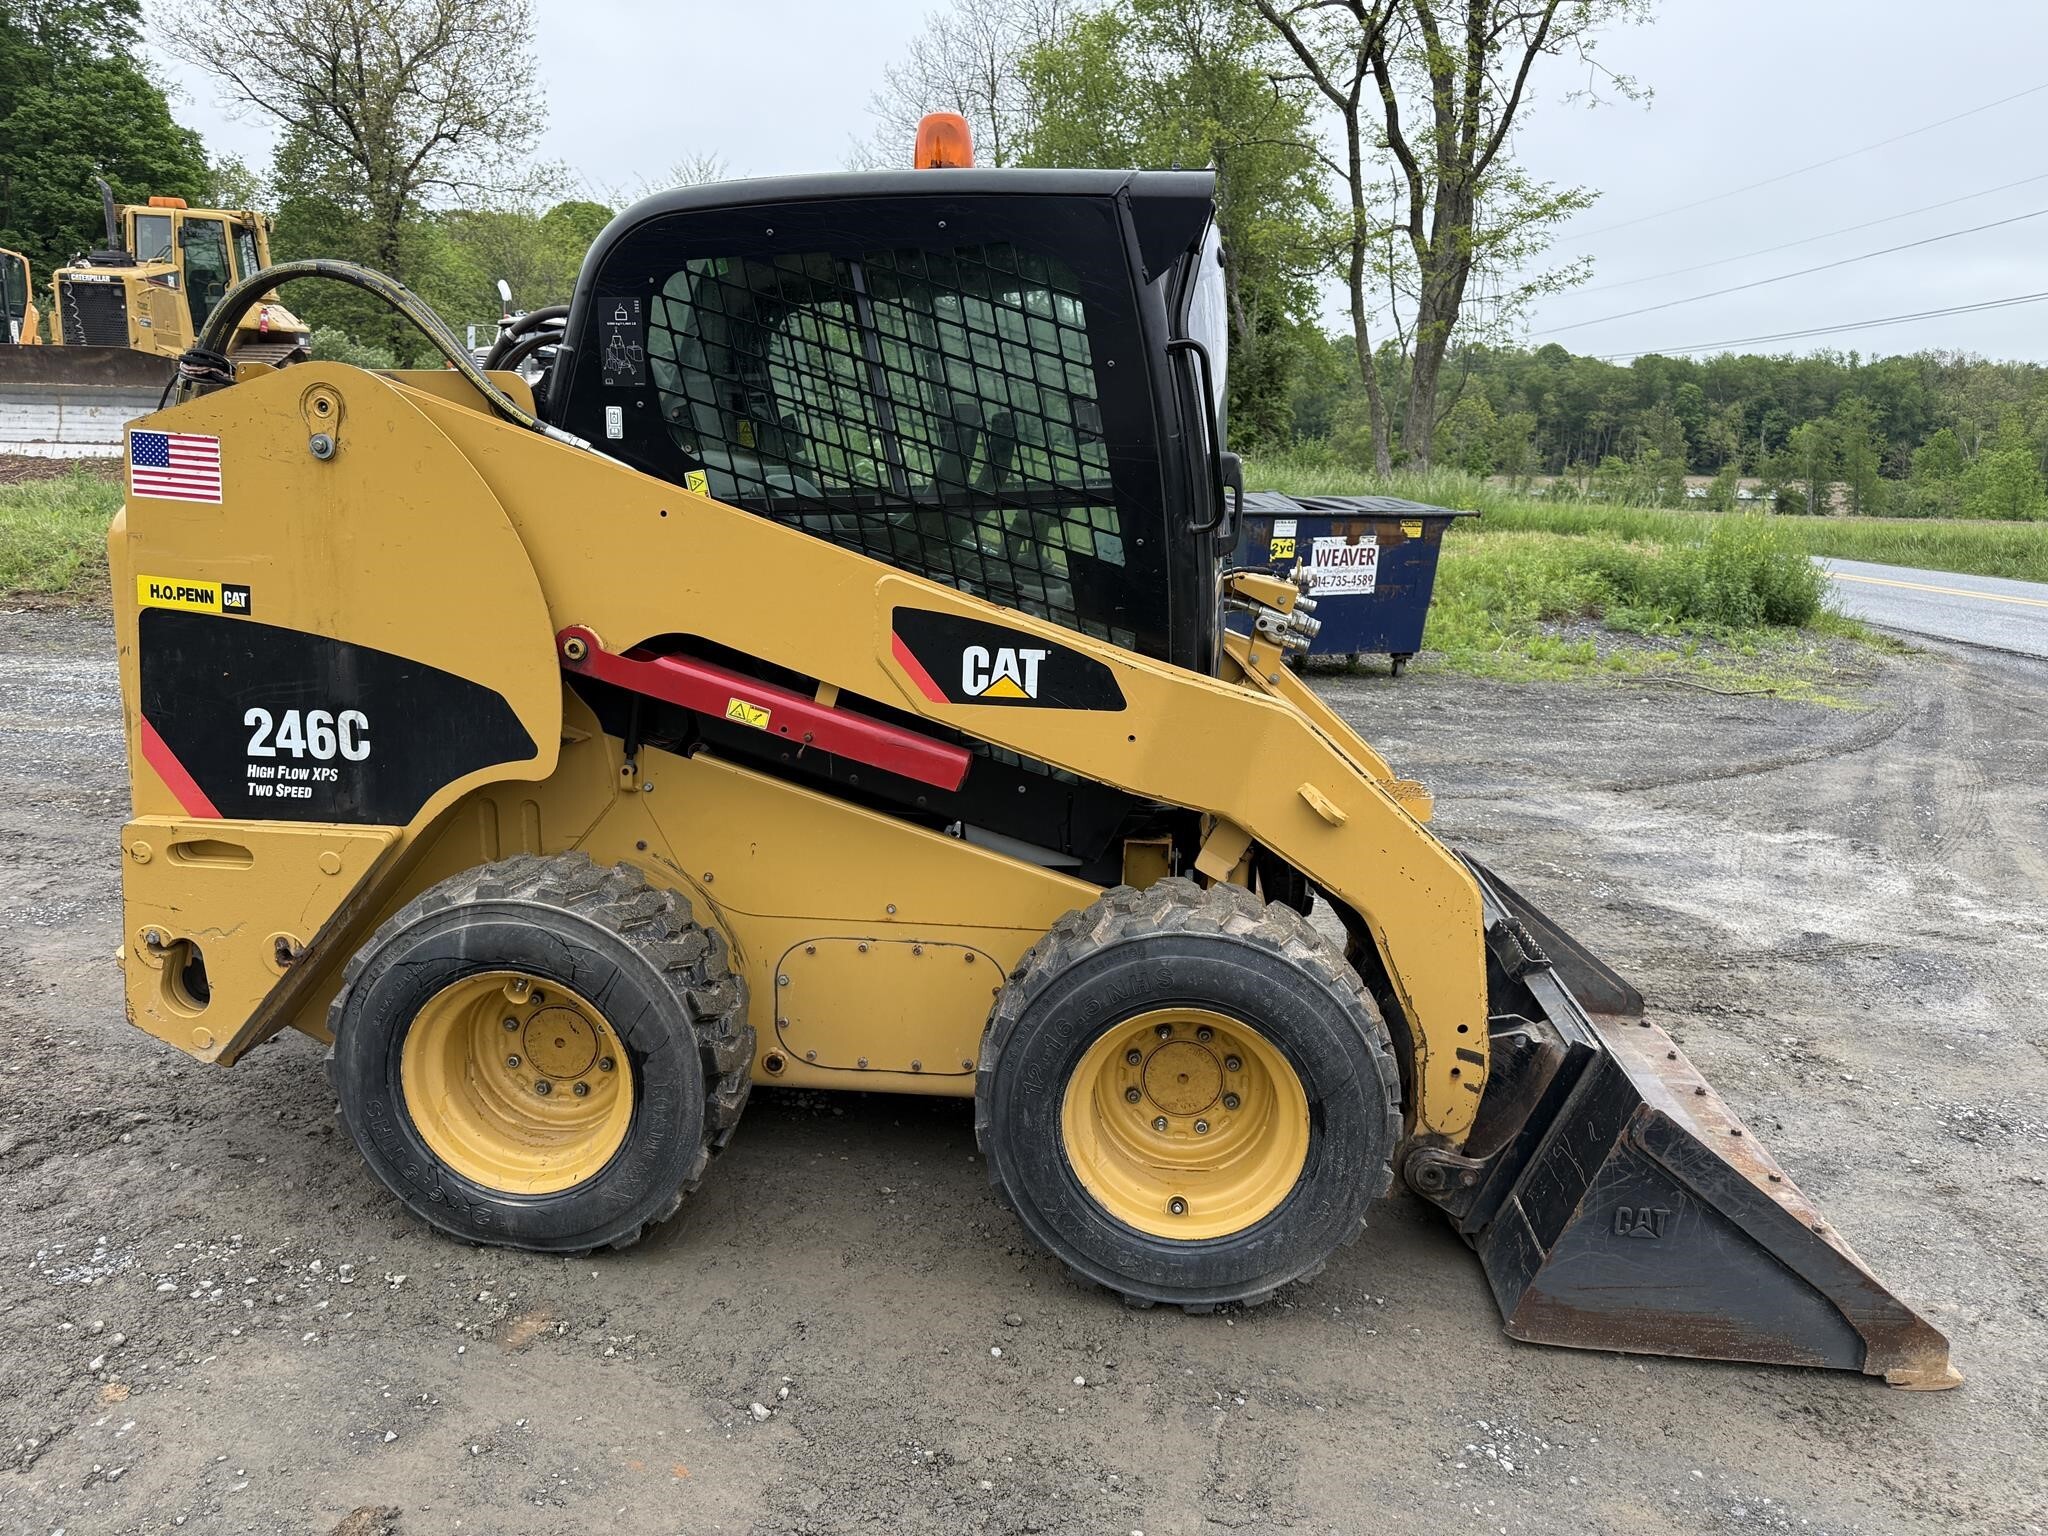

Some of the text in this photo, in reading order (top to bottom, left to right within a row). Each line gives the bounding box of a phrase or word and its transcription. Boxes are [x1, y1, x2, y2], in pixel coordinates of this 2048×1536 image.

[70, 273, 111, 283] CATERPILLAR
[1272, 541, 1294, 554] 2yd
[1315, 547, 1376, 567] WEAVER
[150, 583, 248, 608] H.O.PENN CAT
[962, 645, 1046, 699] CAT
[243, 707, 371, 761] 246C
[311, 767, 339, 782] XPS
[1106, 968, 1176, 1004] NHS
[1615, 1206, 1671, 1237] CAT
